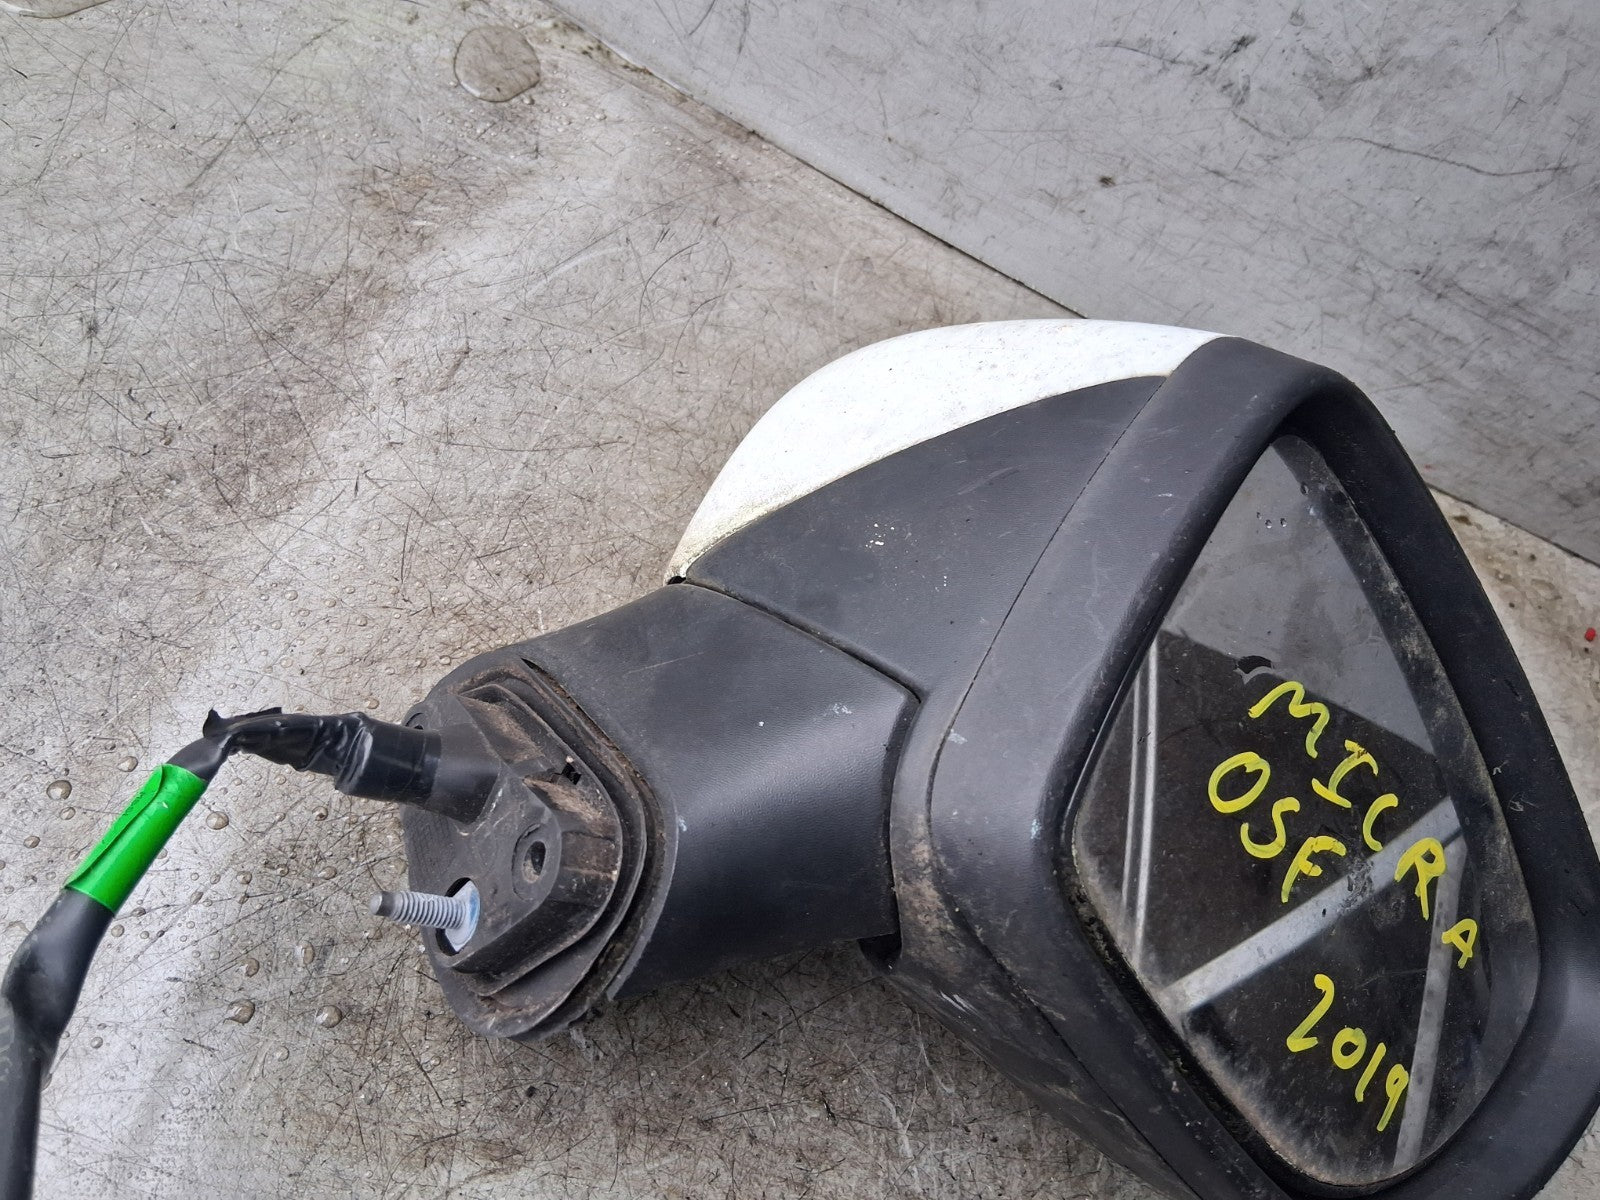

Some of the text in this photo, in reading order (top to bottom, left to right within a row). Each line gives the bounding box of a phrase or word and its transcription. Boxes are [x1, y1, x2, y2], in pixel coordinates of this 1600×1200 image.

[1208, 751, 1346, 902] OSF
[1249, 681, 1479, 968] MICRA
[1286, 973, 1410, 1131] 2019
